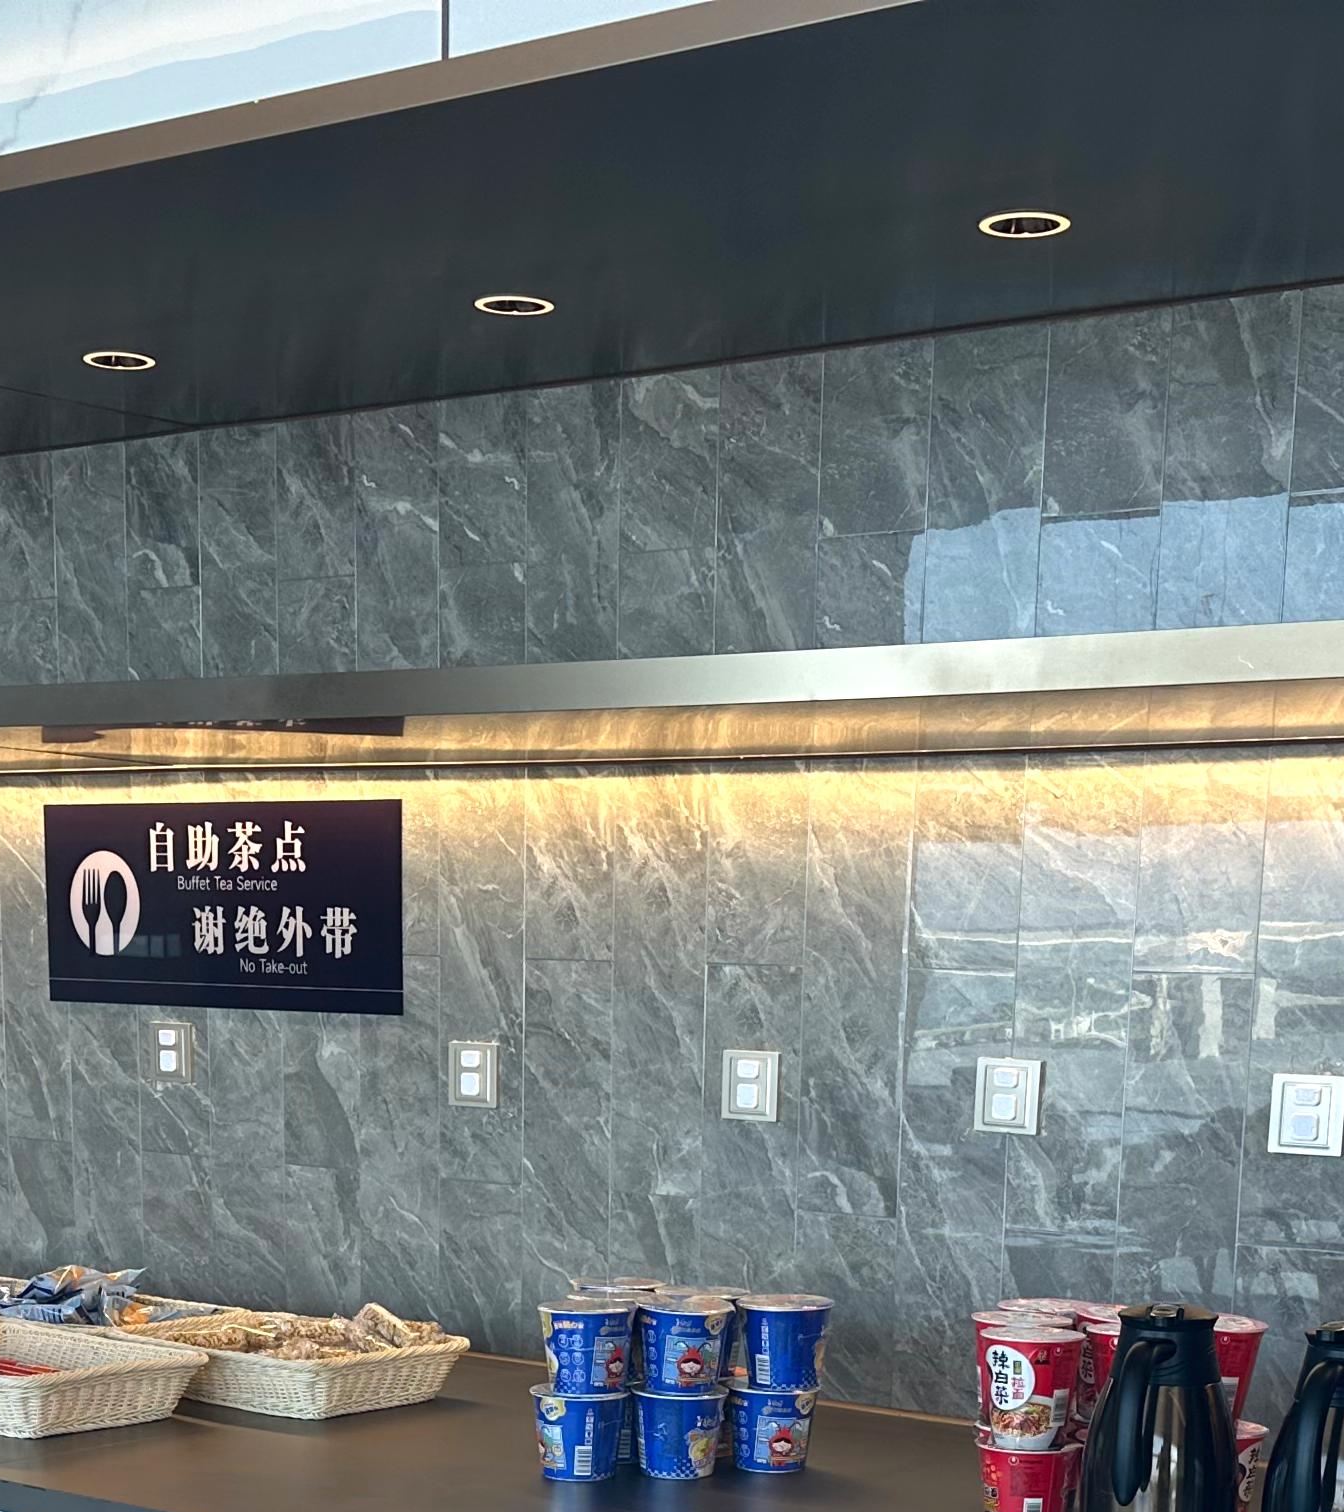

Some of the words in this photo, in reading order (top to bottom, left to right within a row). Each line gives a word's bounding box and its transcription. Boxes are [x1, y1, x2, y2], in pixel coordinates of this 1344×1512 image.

[148, 820, 307, 873] 自助茶点
[177, 876, 210, 891] Buffet
[214, 876, 233, 891] Tea
[236, 876, 278, 892] Service
[191, 905, 358, 959] 谢绝外带
[239, 958, 256, 973] No
[259, 959, 308, 975] Take-out
[991, 1349, 1010, 1406] 辣白菜
